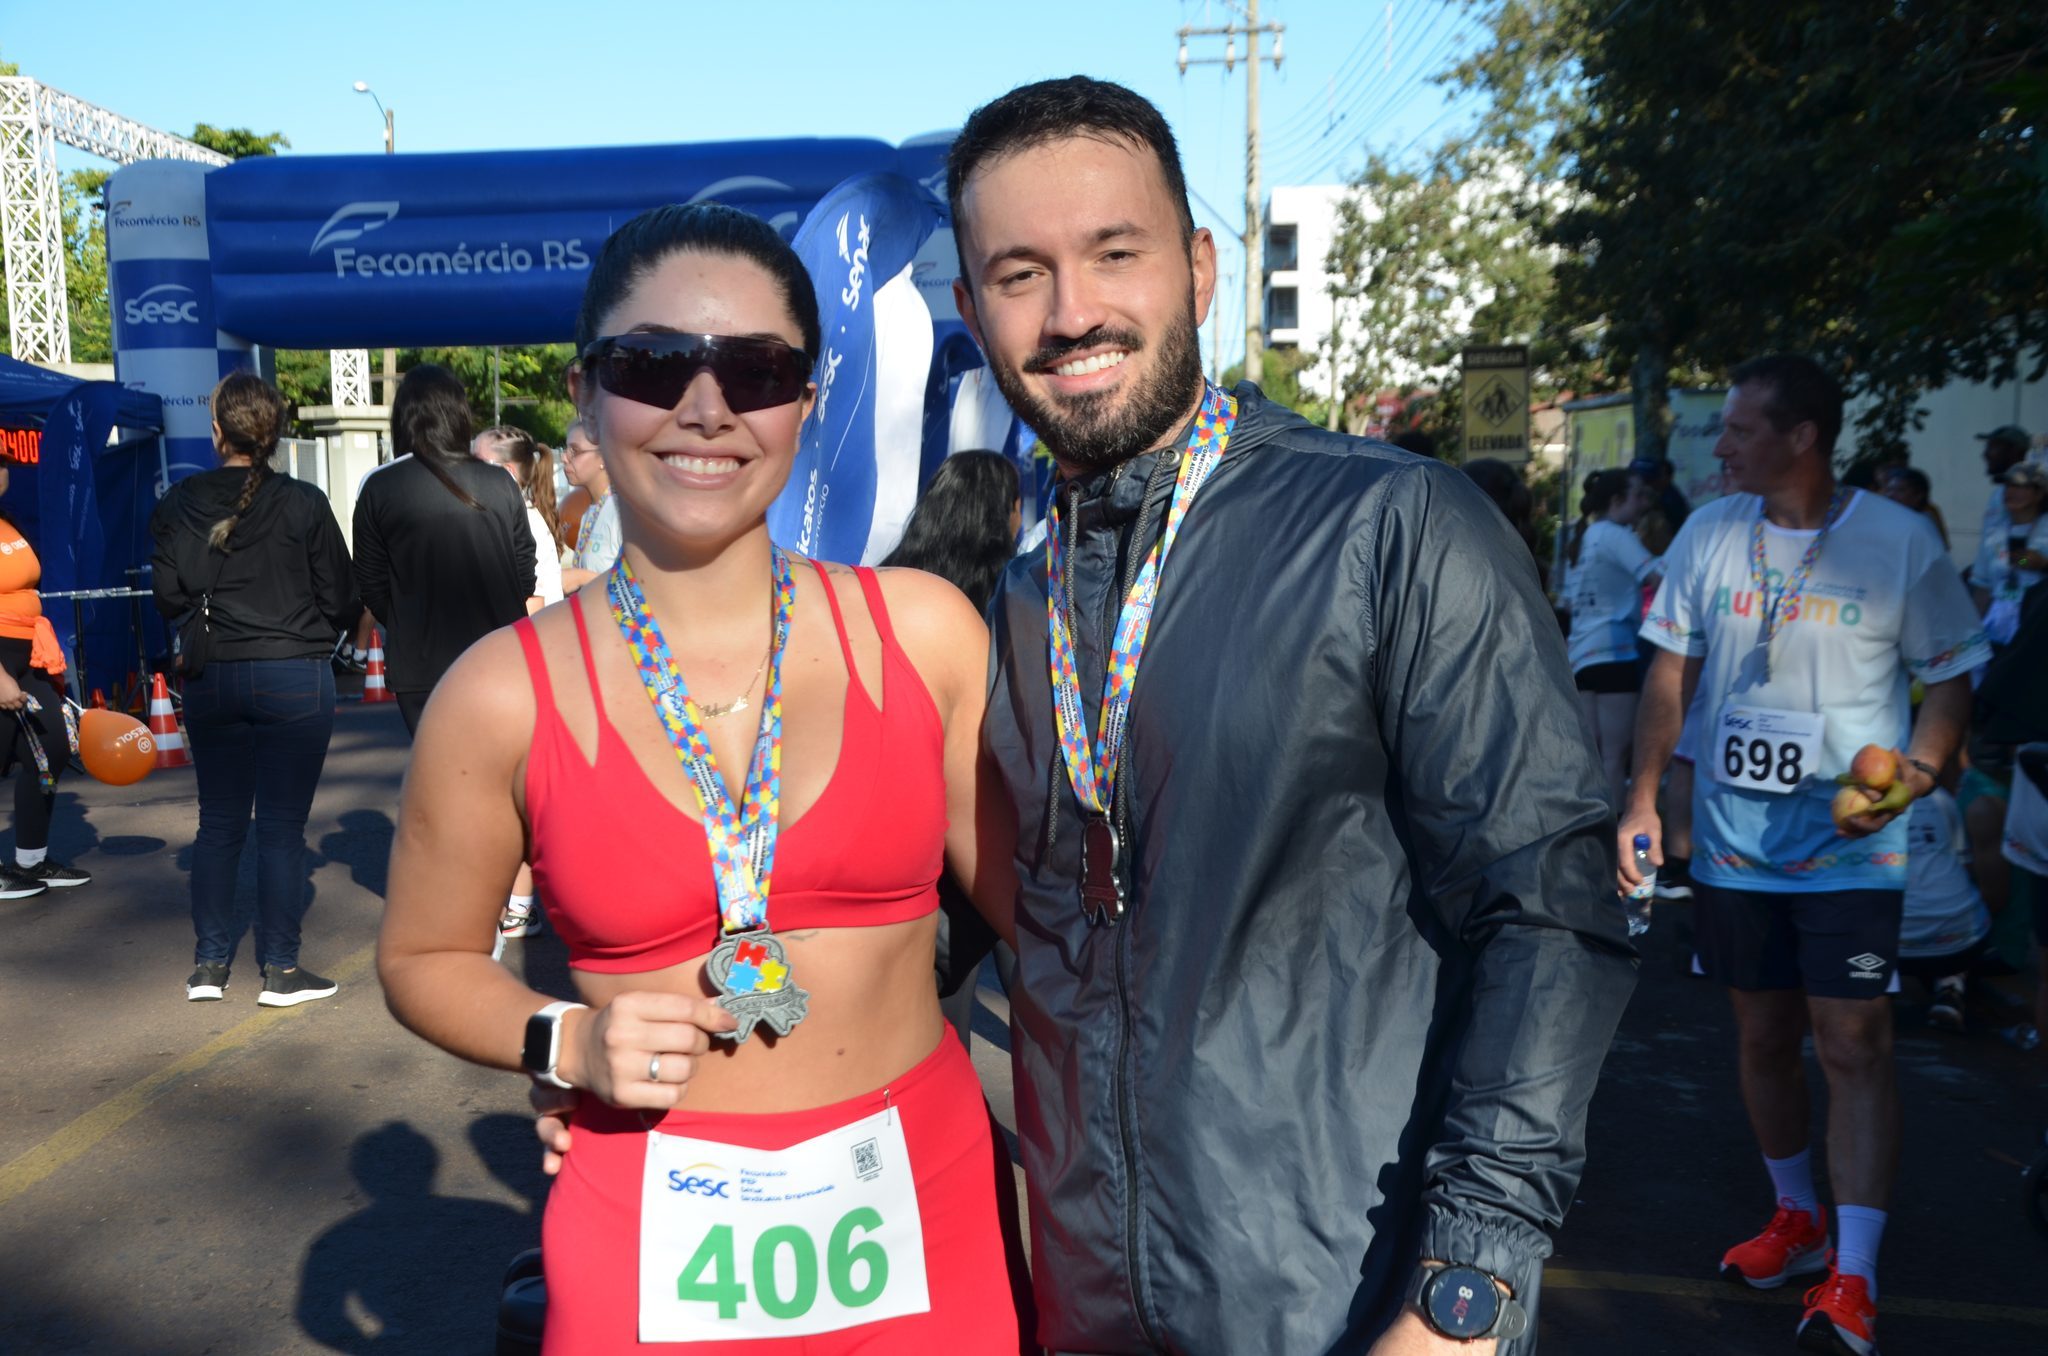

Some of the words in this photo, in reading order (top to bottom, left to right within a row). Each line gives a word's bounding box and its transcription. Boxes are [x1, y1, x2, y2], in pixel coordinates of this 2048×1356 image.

[115, 215, 180, 228] Fecomércio
[183, 216, 201, 227] RS
[334, 242, 532, 278] Fecomércio
[542, 239, 590, 271] RS
[1725, 735, 1803, 785] 698
[677, 1206, 889, 1320] 406
